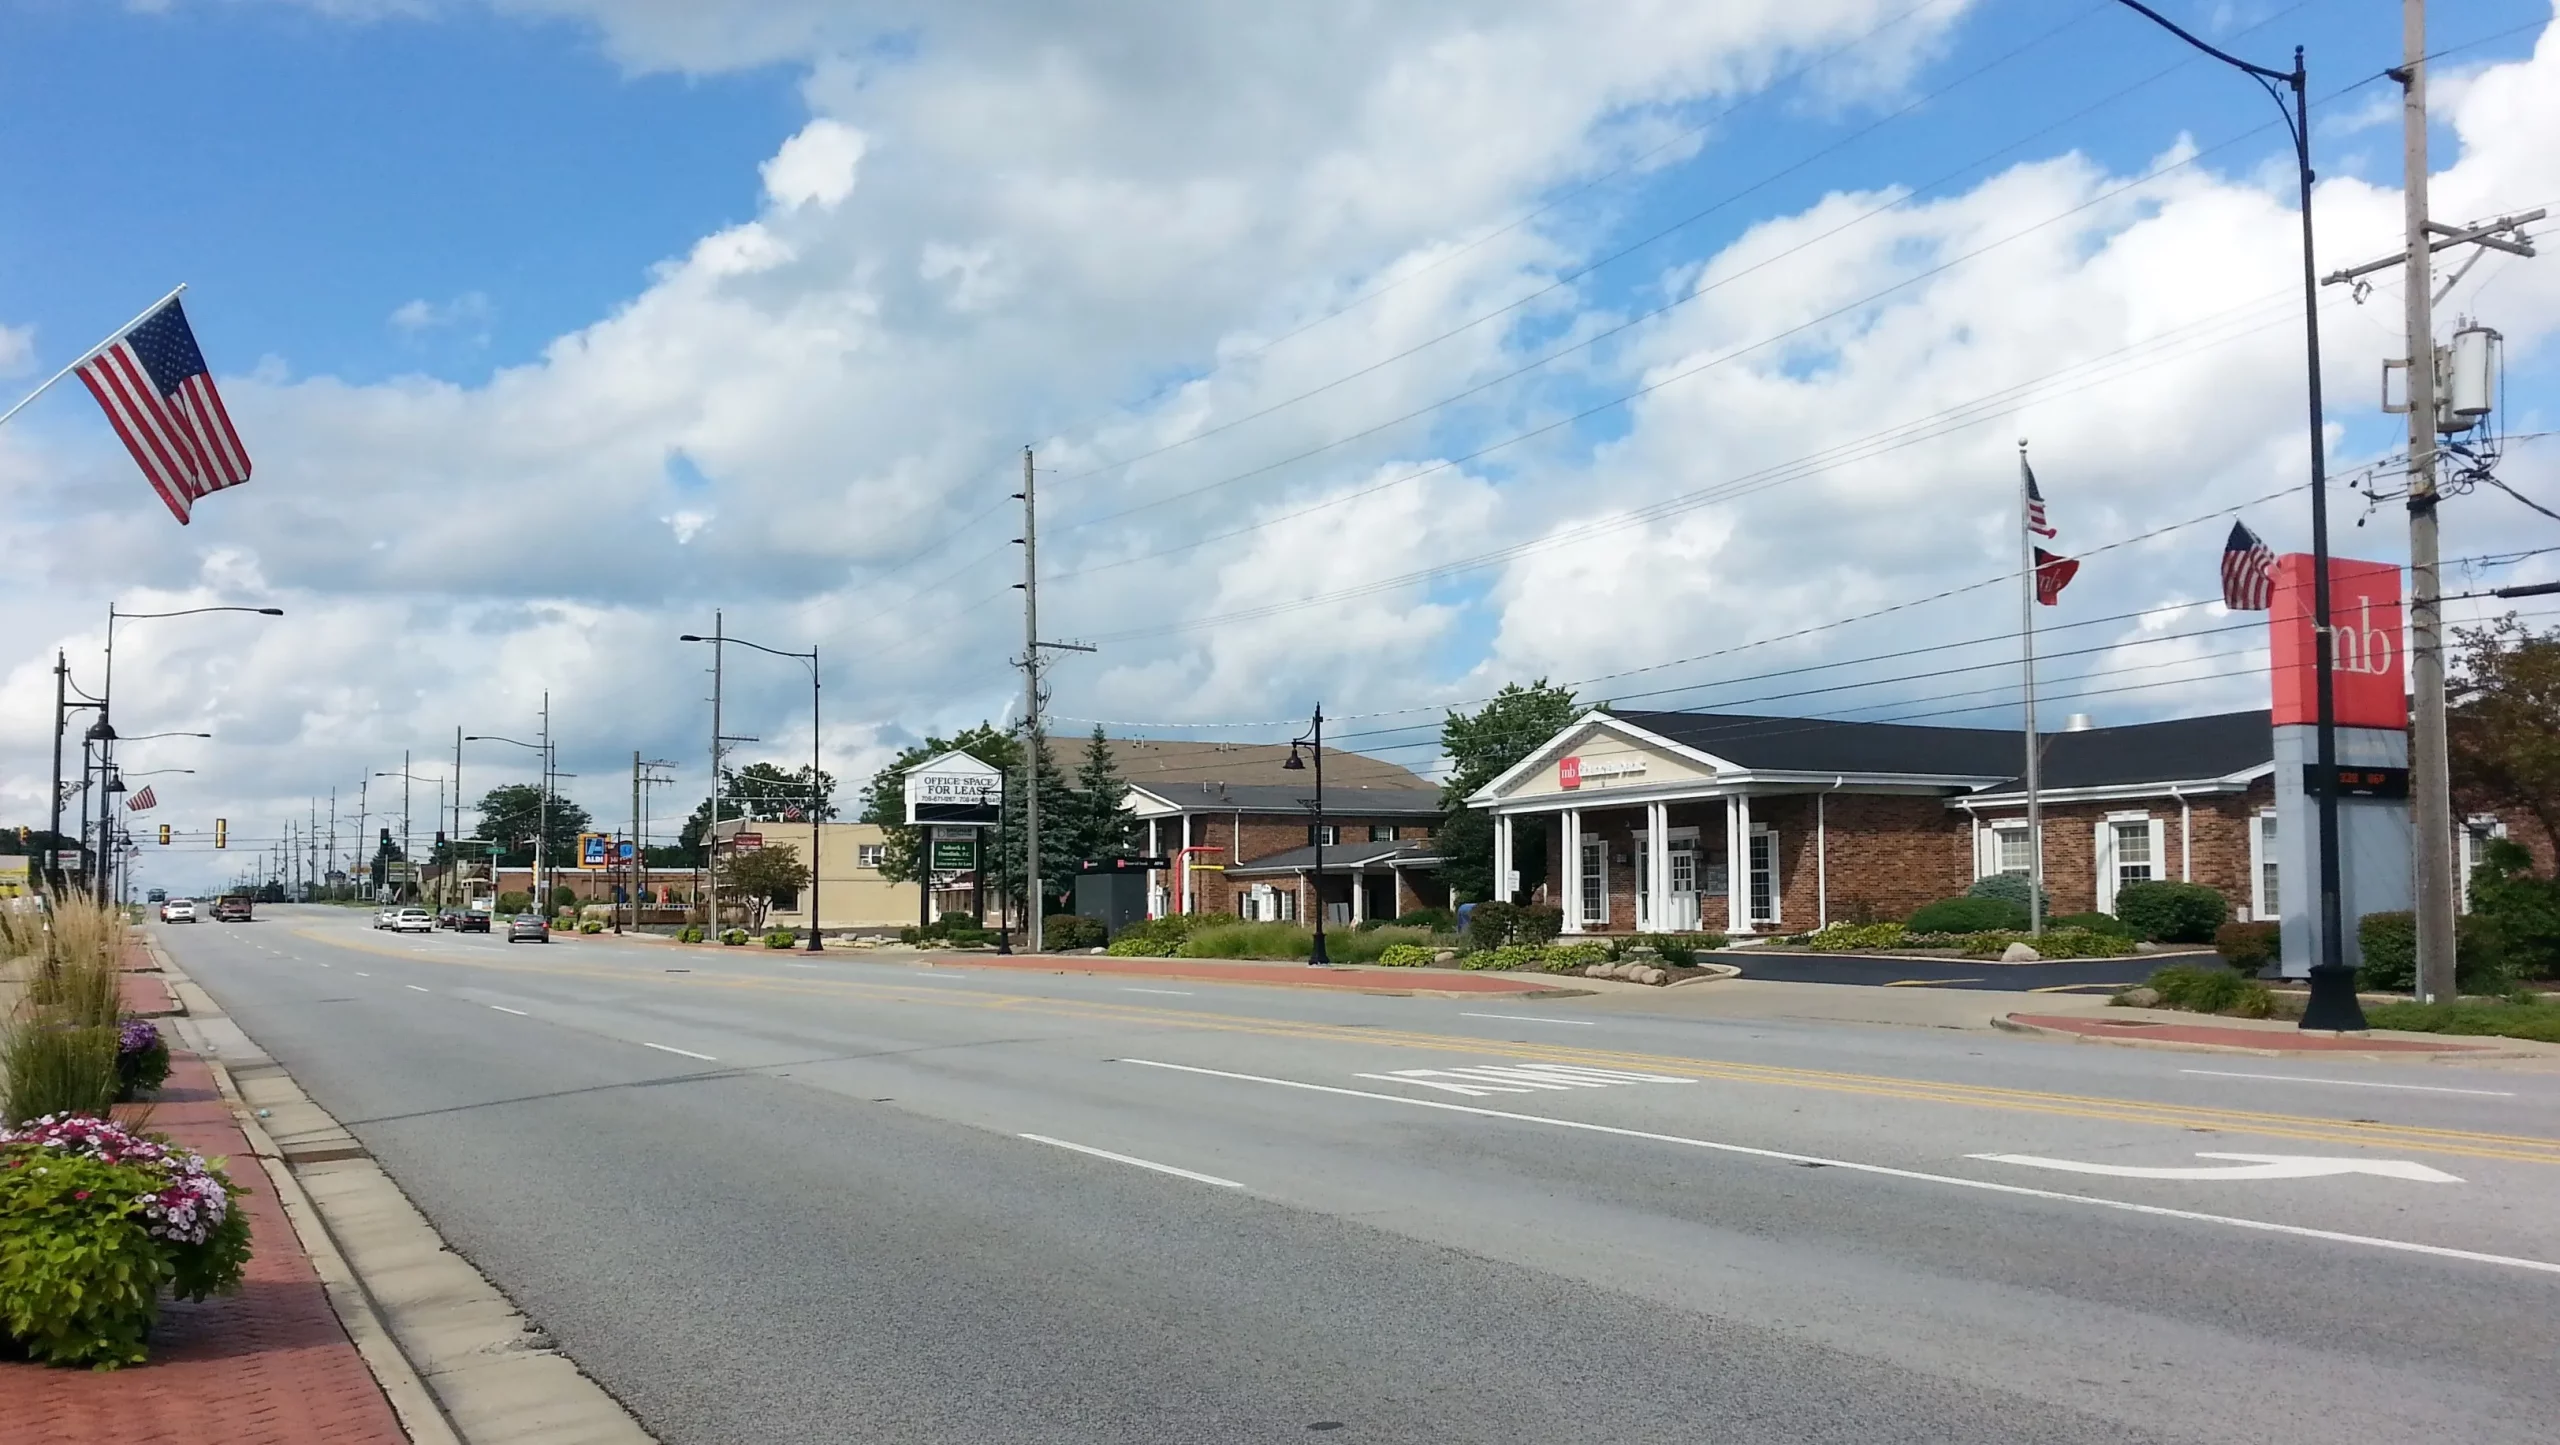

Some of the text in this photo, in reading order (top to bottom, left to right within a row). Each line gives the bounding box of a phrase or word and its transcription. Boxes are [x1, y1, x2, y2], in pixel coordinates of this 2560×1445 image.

[1561, 763, 1575, 778] mb
[924, 777, 993, 786] OFFICE SPACE
[928, 785, 951, 795] FOR
[585, 856, 604, 864] ALDI
